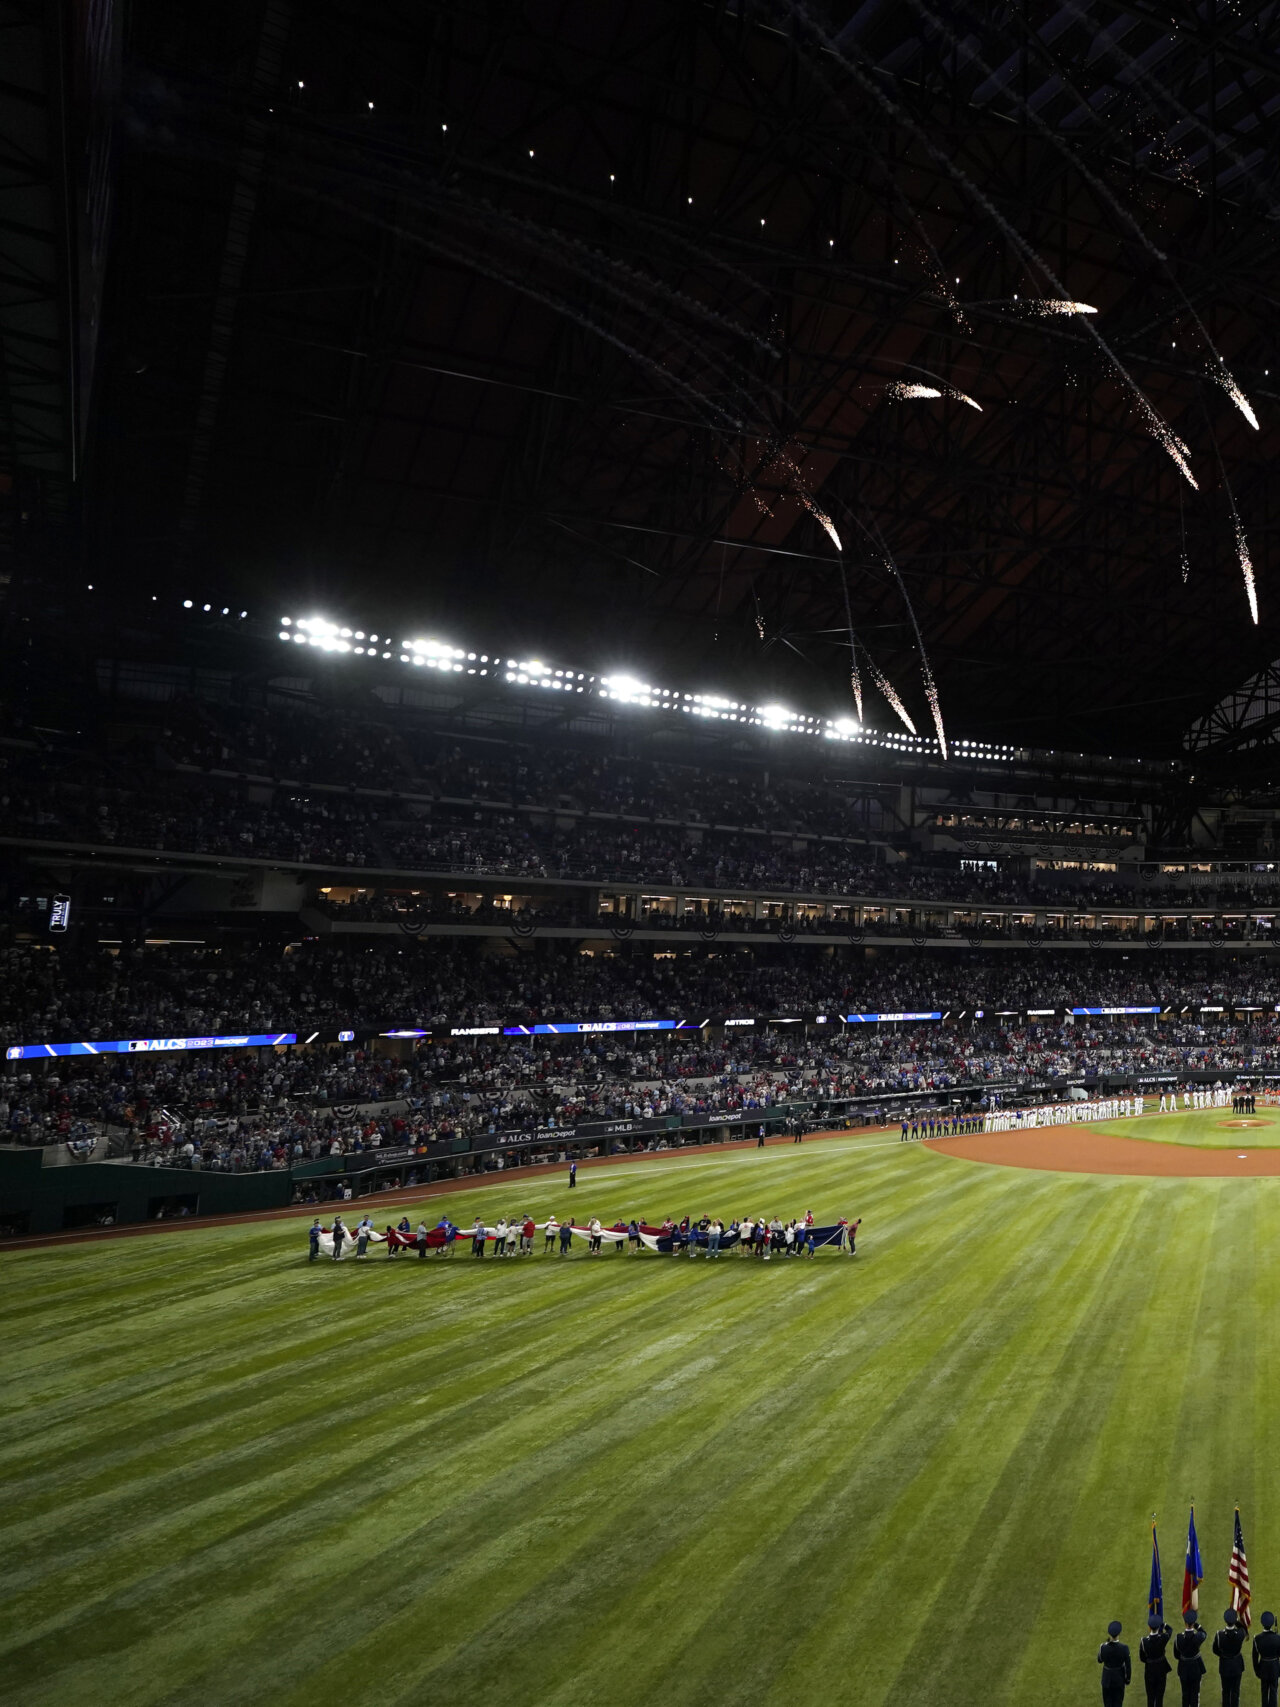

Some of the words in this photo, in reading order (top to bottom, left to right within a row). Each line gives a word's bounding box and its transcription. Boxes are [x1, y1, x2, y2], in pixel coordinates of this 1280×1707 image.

[51, 900, 63, 926] TRULY
[592, 1022, 617, 1032] ALCS
[724, 1018, 755, 1026] ASTROS
[451, 1027, 499, 1036] RANGERS
[150, 1038, 187, 1051] ALCS
[187, 1038, 213, 1048] 2023
[708, 1112, 742, 1122] loanDepot
[614, 1123, 633, 1132] MLB
[507, 1133, 532, 1143] ALCS
[536, 1129, 576, 1140] loanDepot
